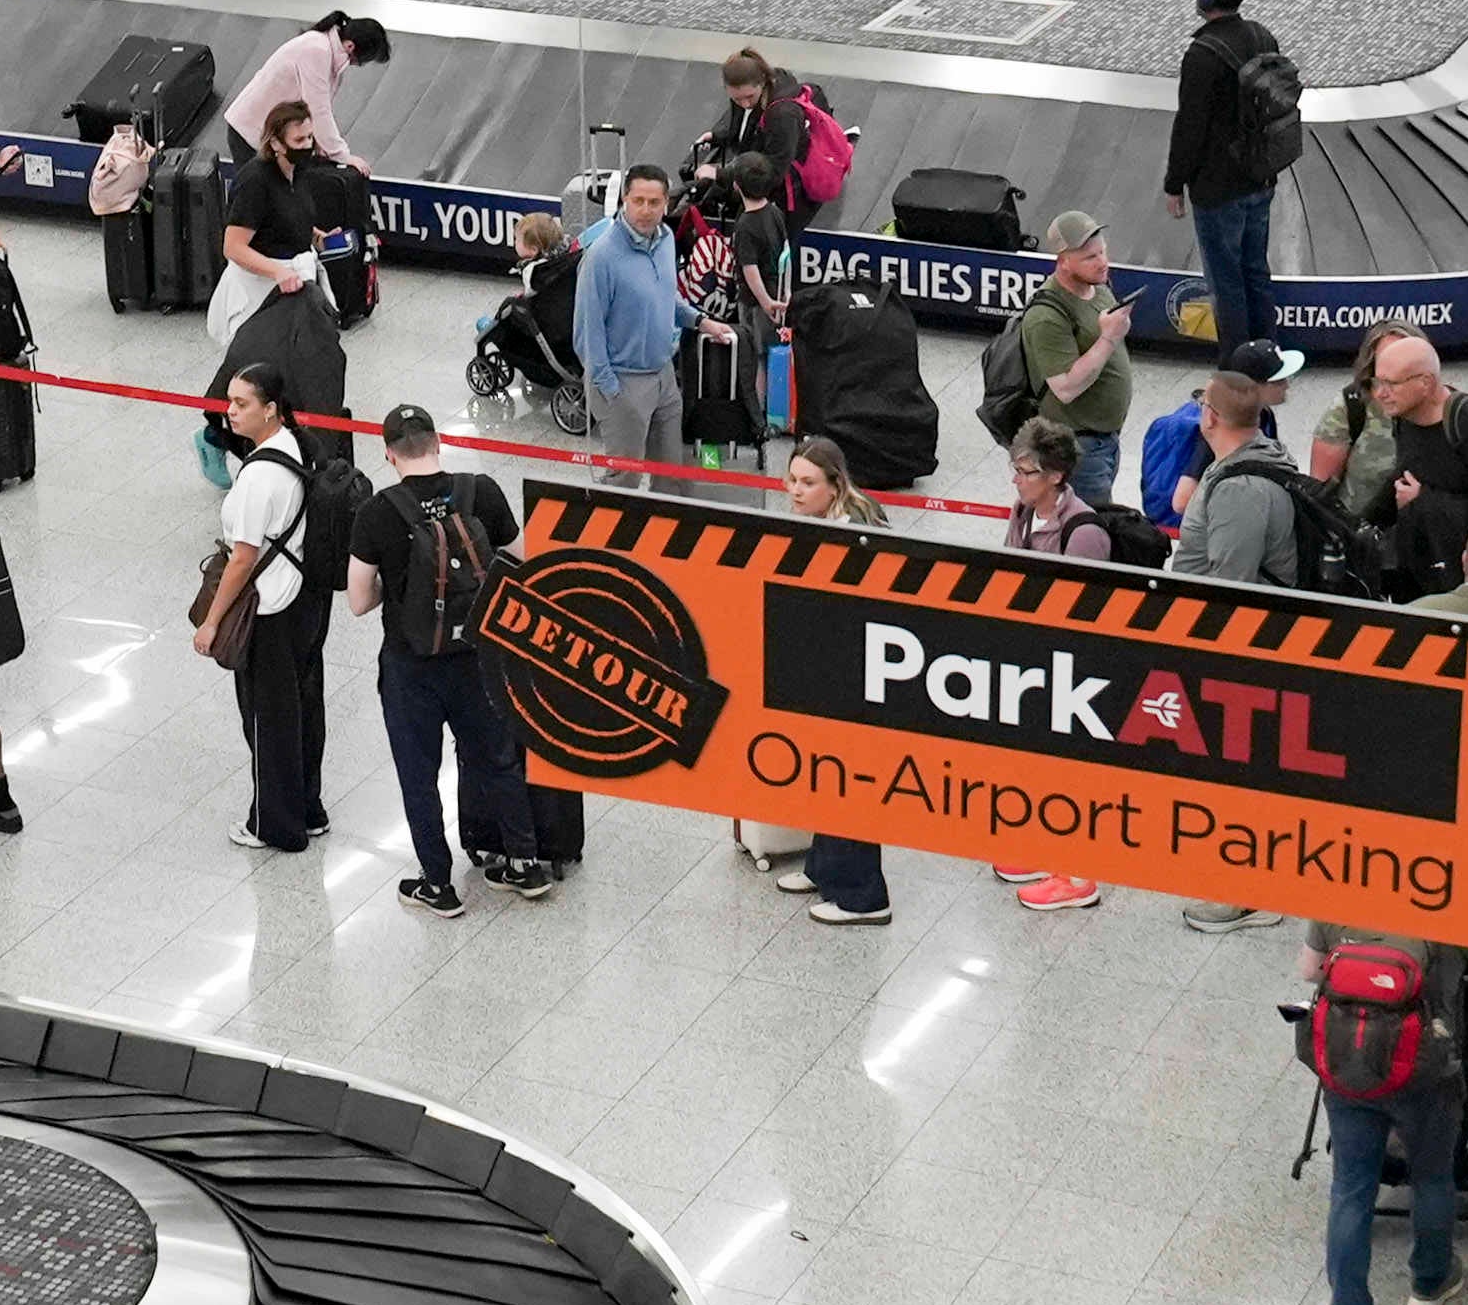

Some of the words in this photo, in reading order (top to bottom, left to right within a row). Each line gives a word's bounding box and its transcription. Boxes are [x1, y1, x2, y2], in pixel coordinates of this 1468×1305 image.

[370, 194, 429, 241] ATL,
[799, 245, 872, 285] BAG
[880, 255, 973, 303] FLIES
[571, 453, 592, 465] ATL
[924, 499, 948, 511] ATL
[497, 597, 689, 728] DETOUR
[746, 731, 1140, 849] On-Airport
[1171, 801, 1455, 911] Parking
